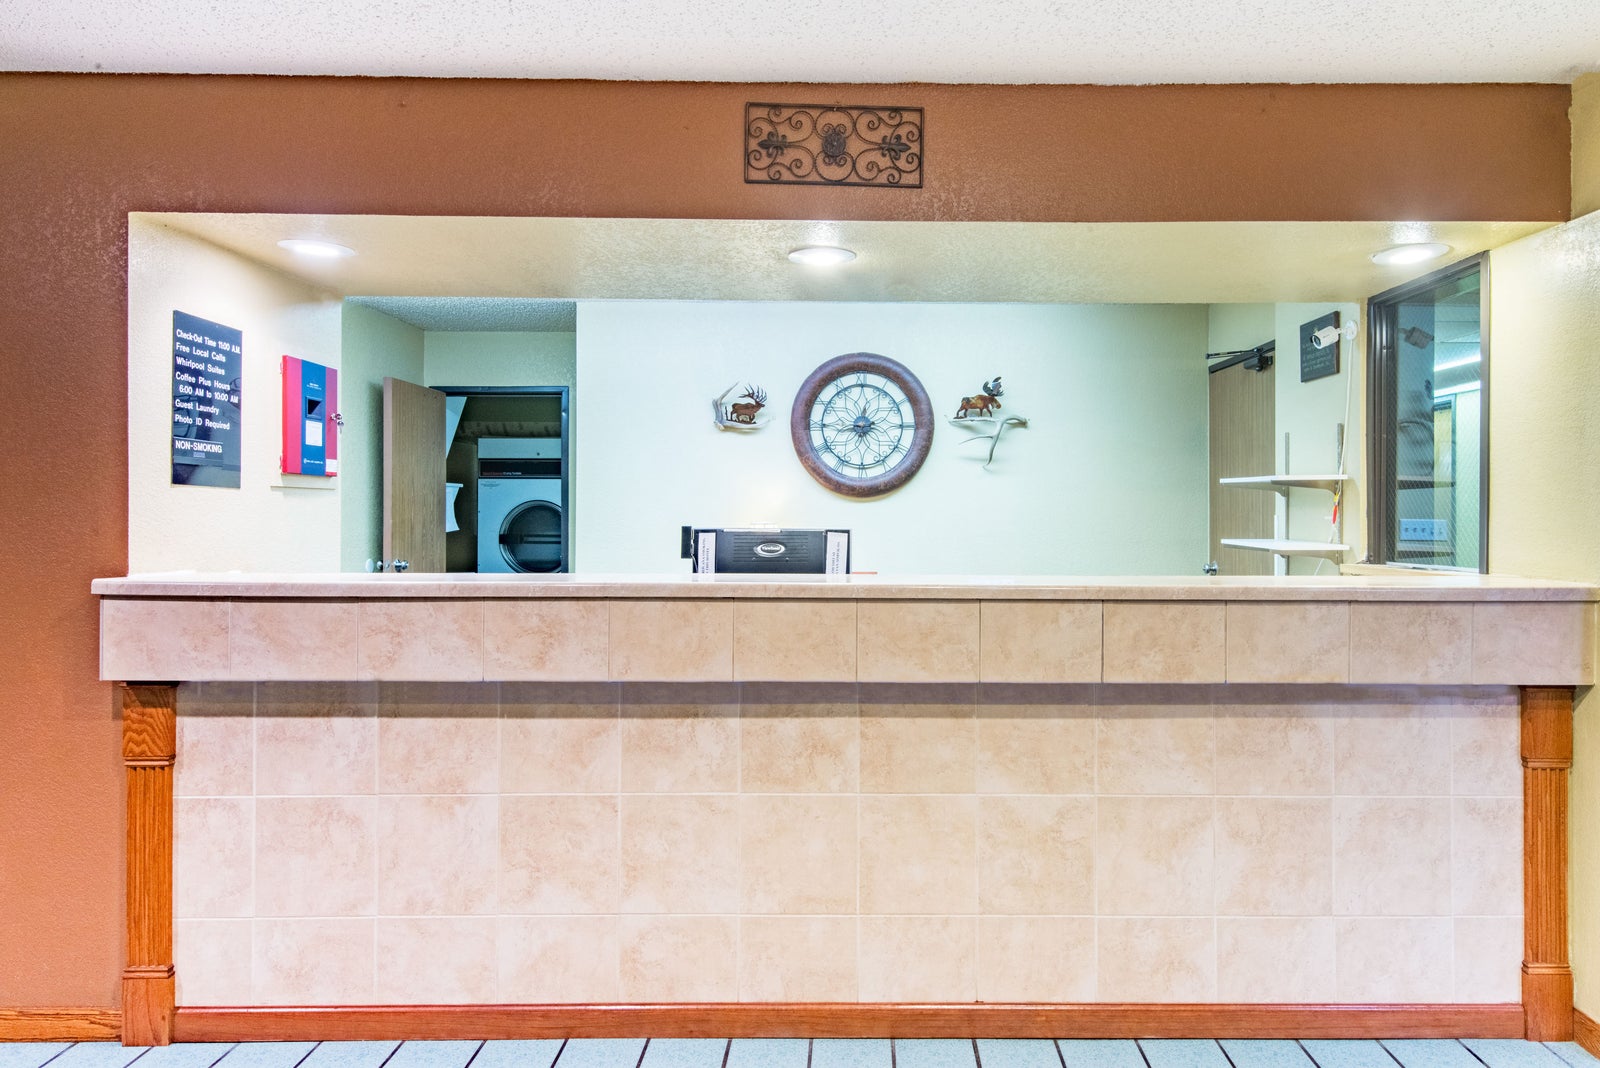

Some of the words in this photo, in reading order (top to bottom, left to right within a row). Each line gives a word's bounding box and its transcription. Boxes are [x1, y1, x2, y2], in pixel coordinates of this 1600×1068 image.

[176, 329, 203, 343] Check-Out
[204, 336, 217, 347] Time
[218, 341, 230, 351] 11:00
[176, 342, 190, 353] Free
[192, 347, 209, 358] Local
[211, 352, 226, 362] Calls
[176, 356, 205, 370] Whirlpool
[207, 364, 225, 375] Suites
[175, 371, 196, 383] Coffee
[198, 376, 212, 387] Plus
[213, 380, 231, 391] Hours
[179, 384, 193, 395] 6:00
[194, 388, 205, 397] AM
[206, 390, 213, 399] to
[214, 391, 229, 402] 10:00
[230, 395, 239, 404] AM
[174, 398, 194, 410] Guest
[195, 402, 220, 415] Laundry
[174, 413, 193, 425] Photo
[195, 417, 203, 426] ID
[204, 418, 230, 430] Required
[175, 440, 223, 454] NON-SMOKING
